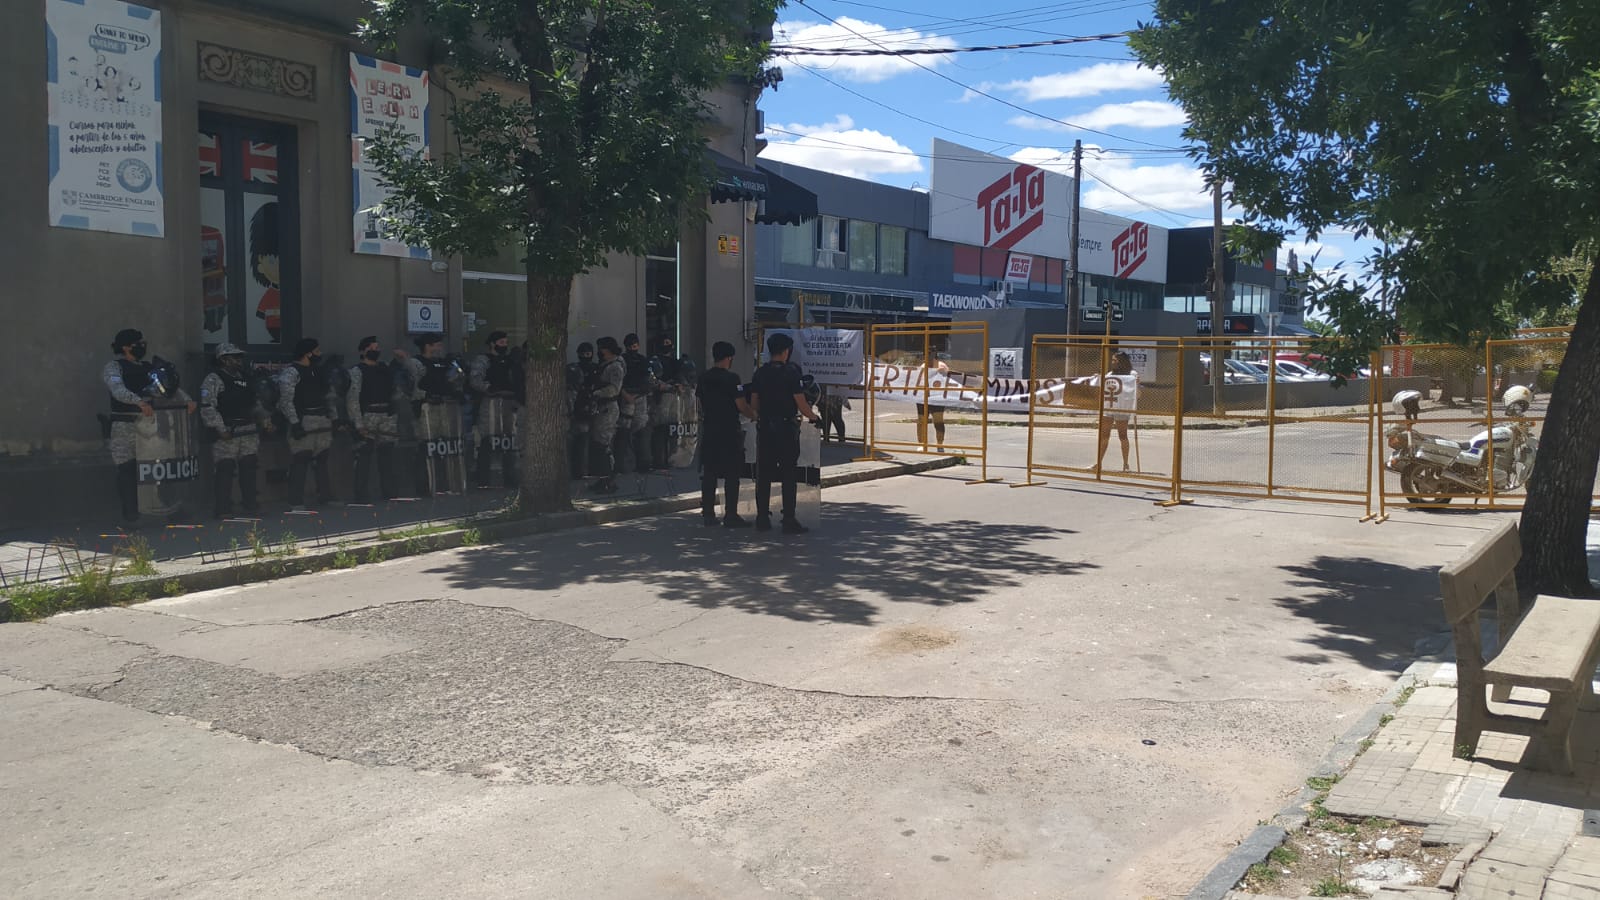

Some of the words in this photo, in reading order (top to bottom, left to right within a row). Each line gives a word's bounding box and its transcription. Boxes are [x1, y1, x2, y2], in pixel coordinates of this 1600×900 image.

[97, 122, 114, 131] para
[101, 132, 109, 141] de
[111, 131, 122, 141] los
[79, 192, 124, 203] CAMBRIDGE
[932, 293, 986, 310] TAEKWONDO
[427, 440, 464, 457] POLIC
